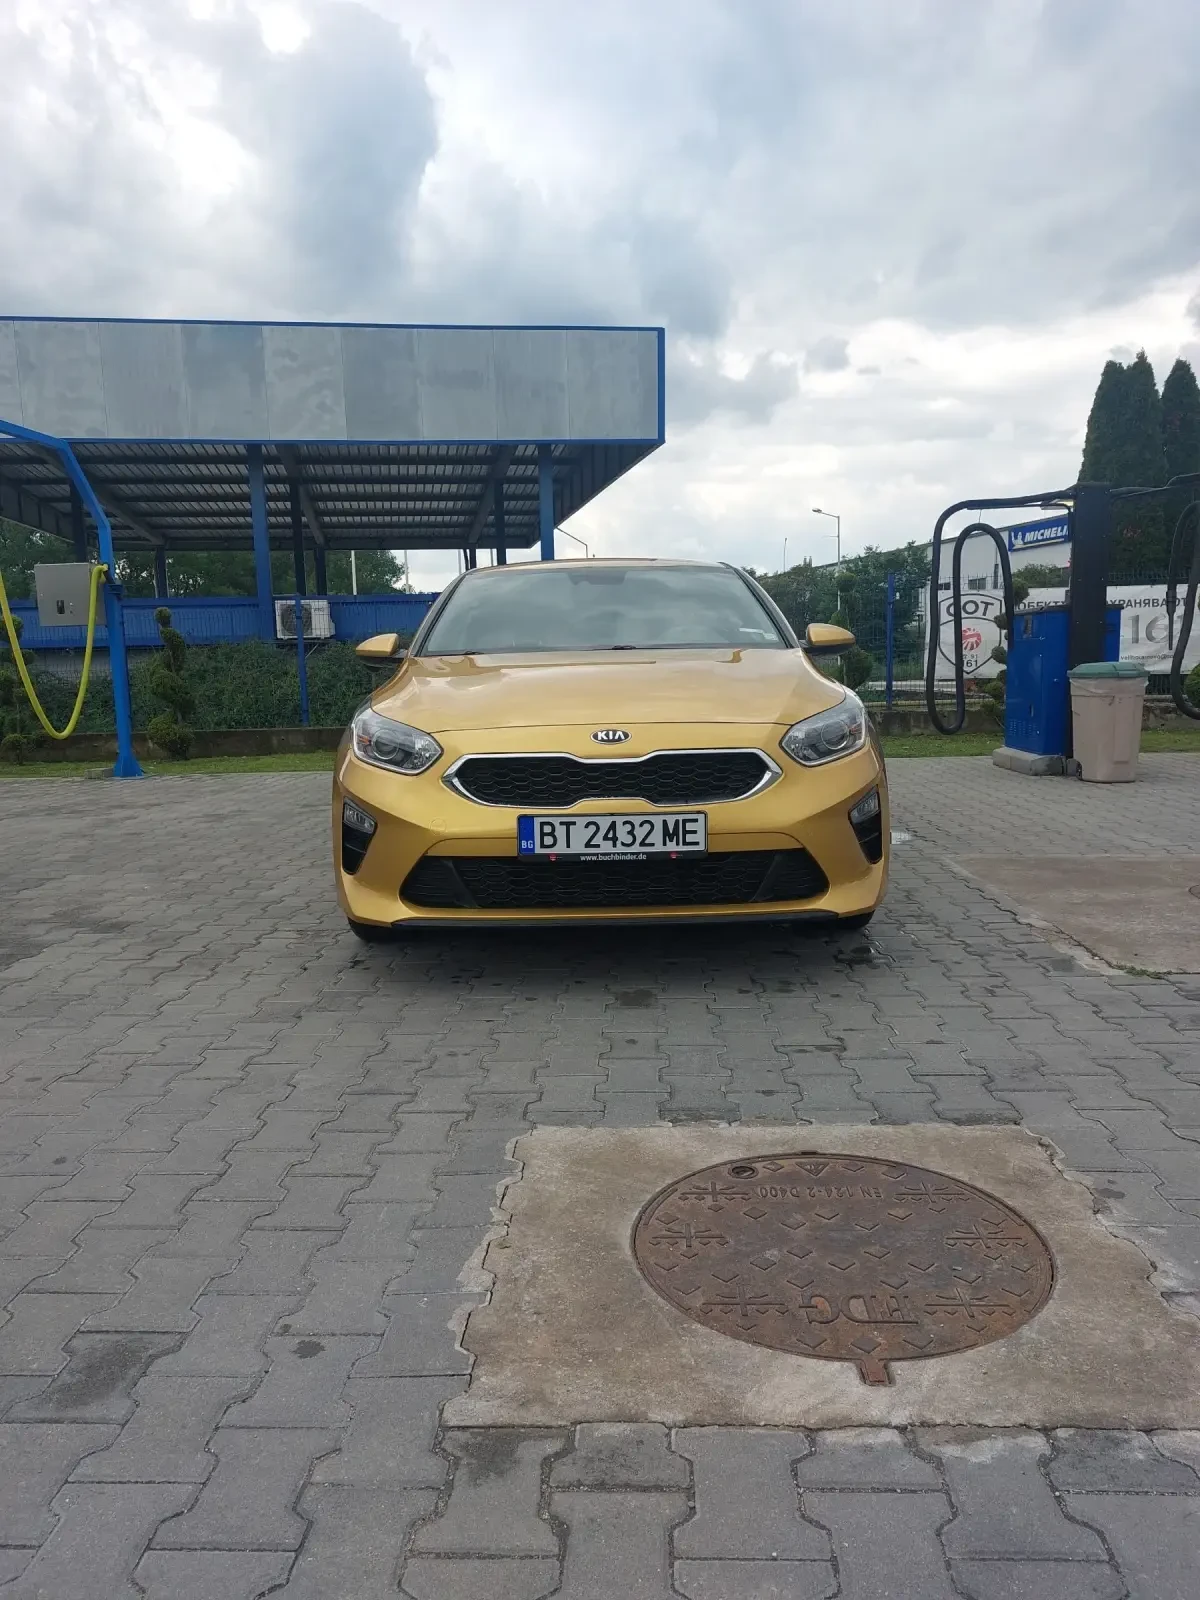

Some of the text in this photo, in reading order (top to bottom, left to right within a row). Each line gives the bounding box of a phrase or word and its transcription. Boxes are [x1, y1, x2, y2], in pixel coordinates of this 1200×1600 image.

[1024, 525, 1068, 543] MICHELI
[1106, 598, 1168, 608] ХРАНЯВА
[597, 730, 625, 741] KIA
[539, 818, 700, 849] BT 2432 ME
[521, 840, 534, 849] BG
[579, 853, 648, 862] www.buchbinder.de
[807, 1186, 855, 1199] 124-2
[859, 1186, 883, 1198] EN
